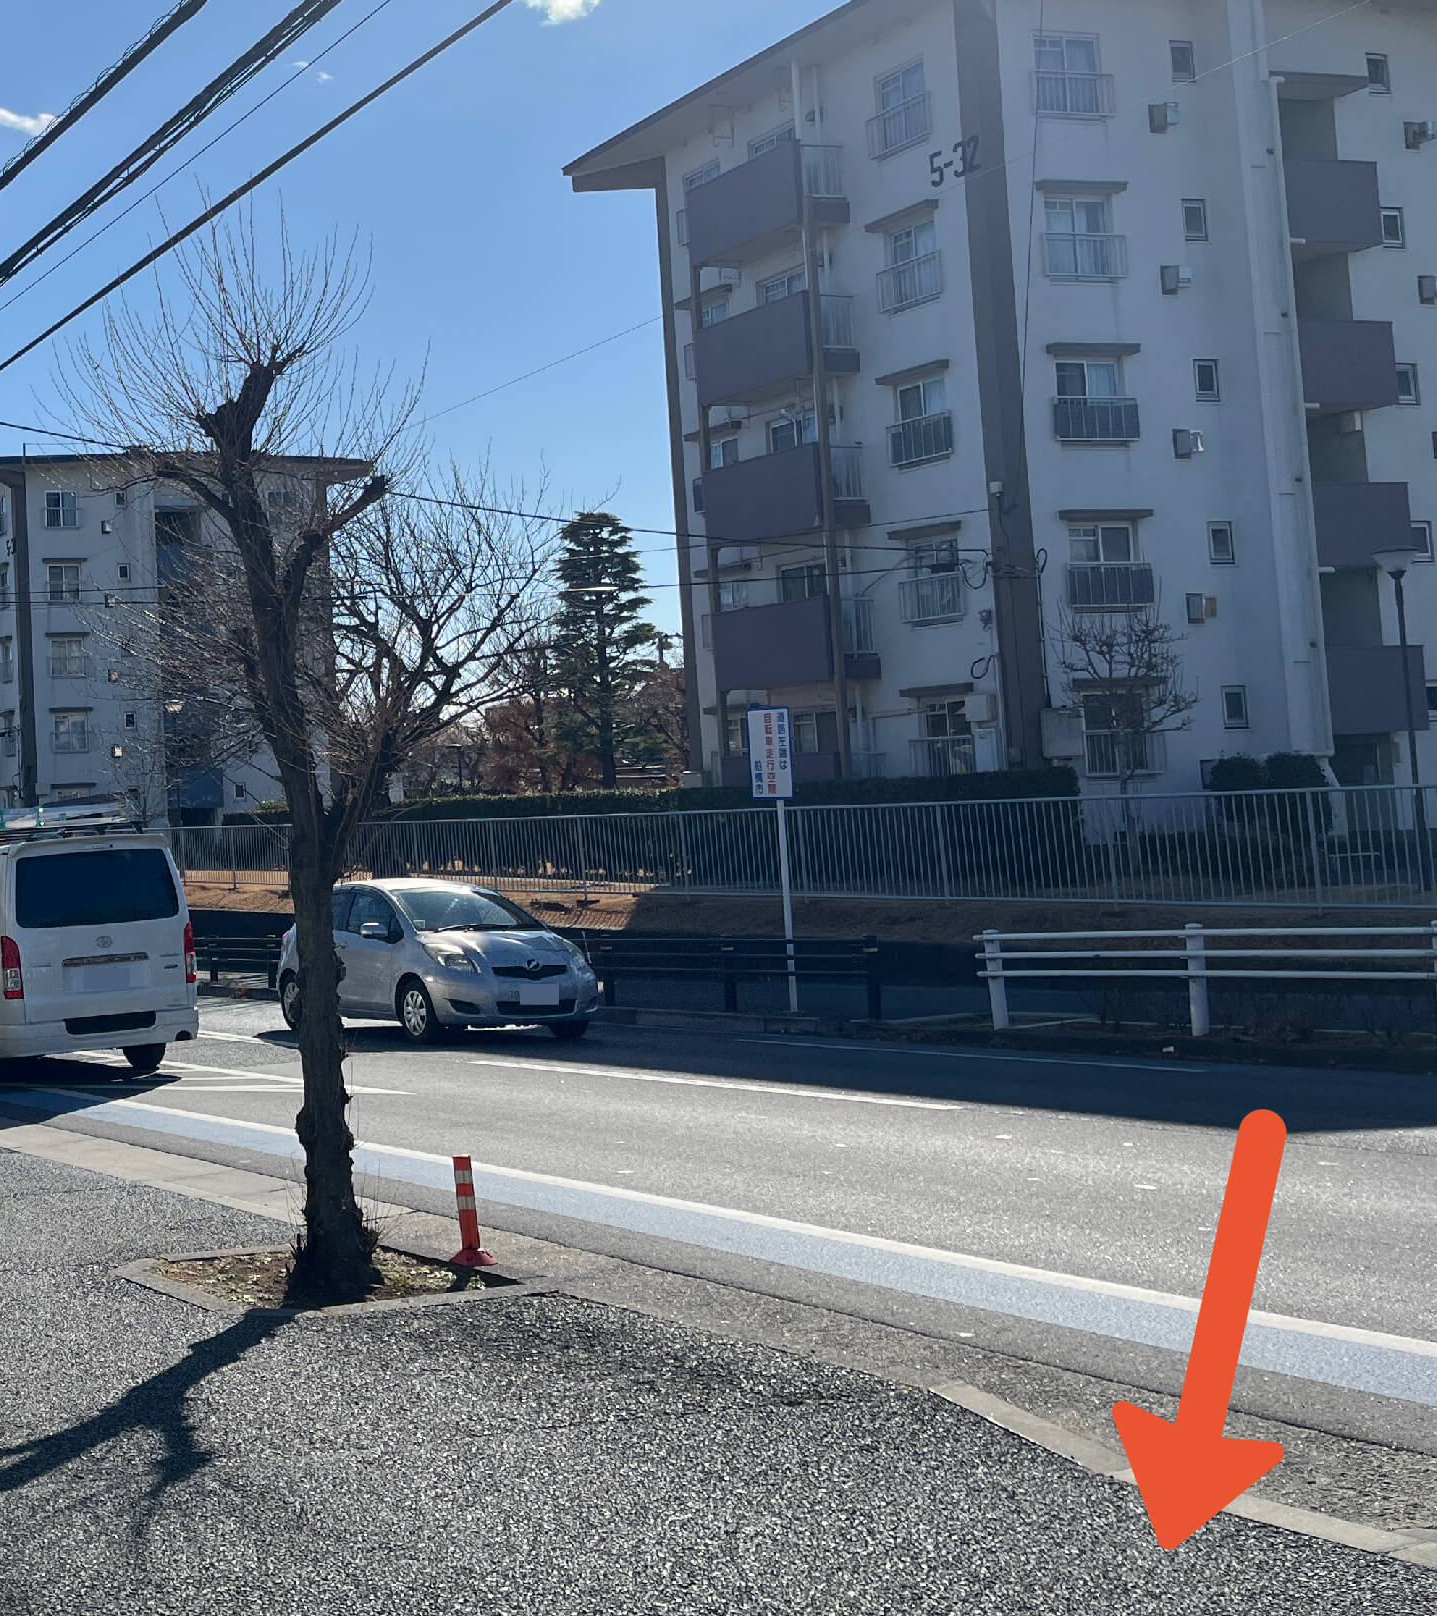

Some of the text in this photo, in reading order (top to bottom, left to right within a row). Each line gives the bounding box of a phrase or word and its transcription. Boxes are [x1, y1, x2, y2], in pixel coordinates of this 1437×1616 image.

[929, 134, 981, 187] 5-32
[754, 760, 764, 795] 船橋市
[764, 712, 777, 795] 自転車走行空間
